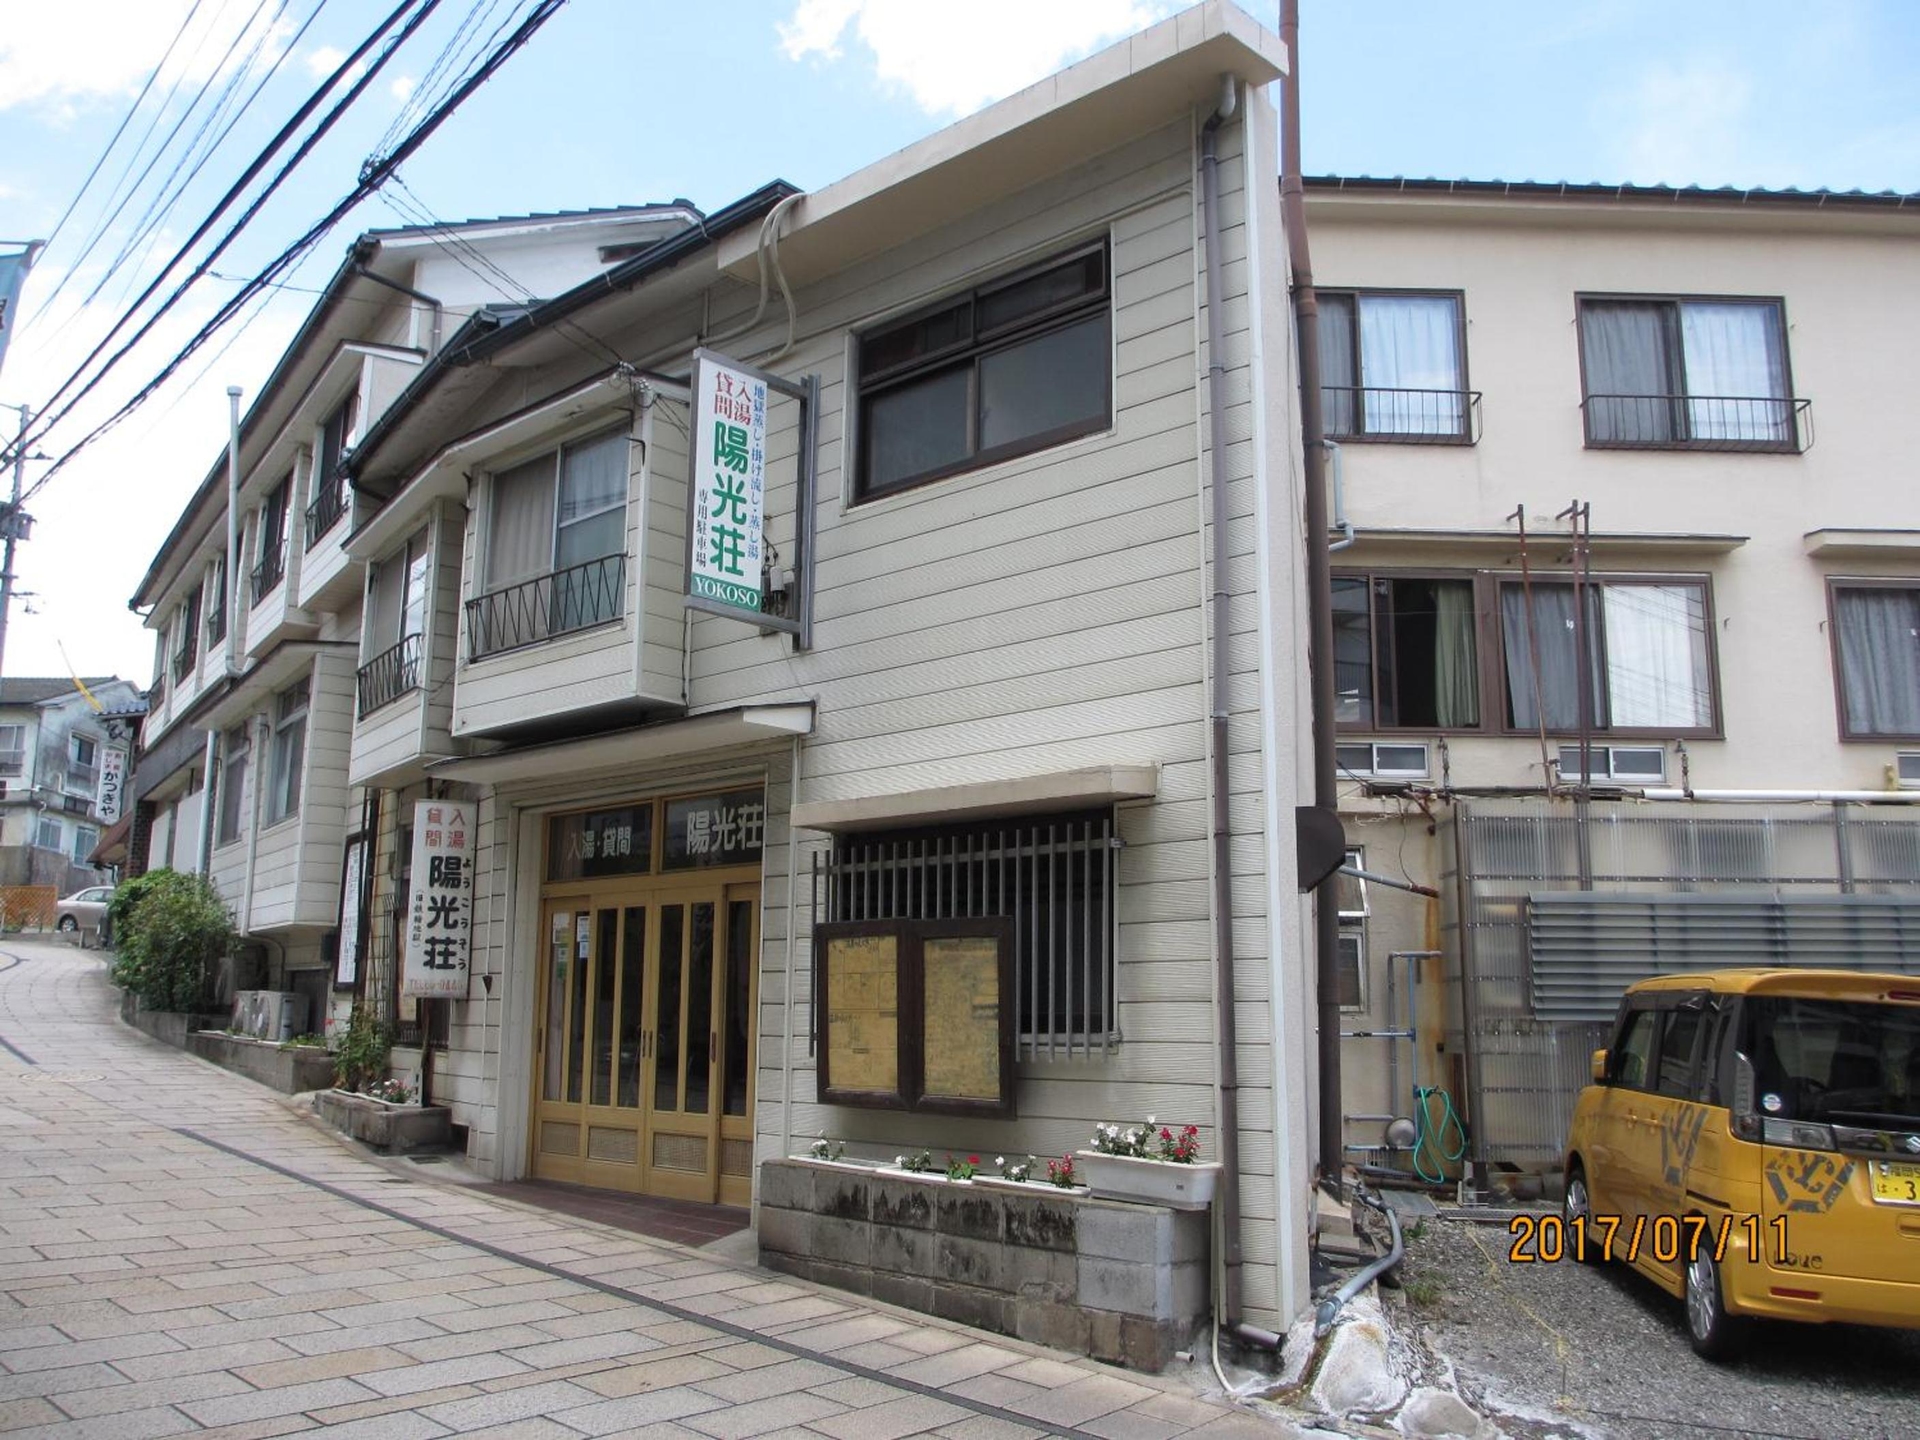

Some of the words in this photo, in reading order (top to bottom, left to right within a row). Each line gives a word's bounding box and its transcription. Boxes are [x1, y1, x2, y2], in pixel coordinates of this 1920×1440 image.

[714, 371, 734, 420] 貸間
[734, 381, 752, 426] 入湯
[710, 421, 749, 577] 陽光荘
[695, 488, 709, 567] 専用駐車場
[695, 576, 759, 608] YOKOSO
[100, 772, 119, 816] かつきや
[425, 807, 442, 848] 貸間
[447, 808, 466, 849] 入湯
[567, 825, 632, 861] 入湯・貸間
[686, 803, 764, 855] 陽光荘
[423, 855, 462, 971] 陽光荘
[457, 857, 472, 971] ようこうそう
